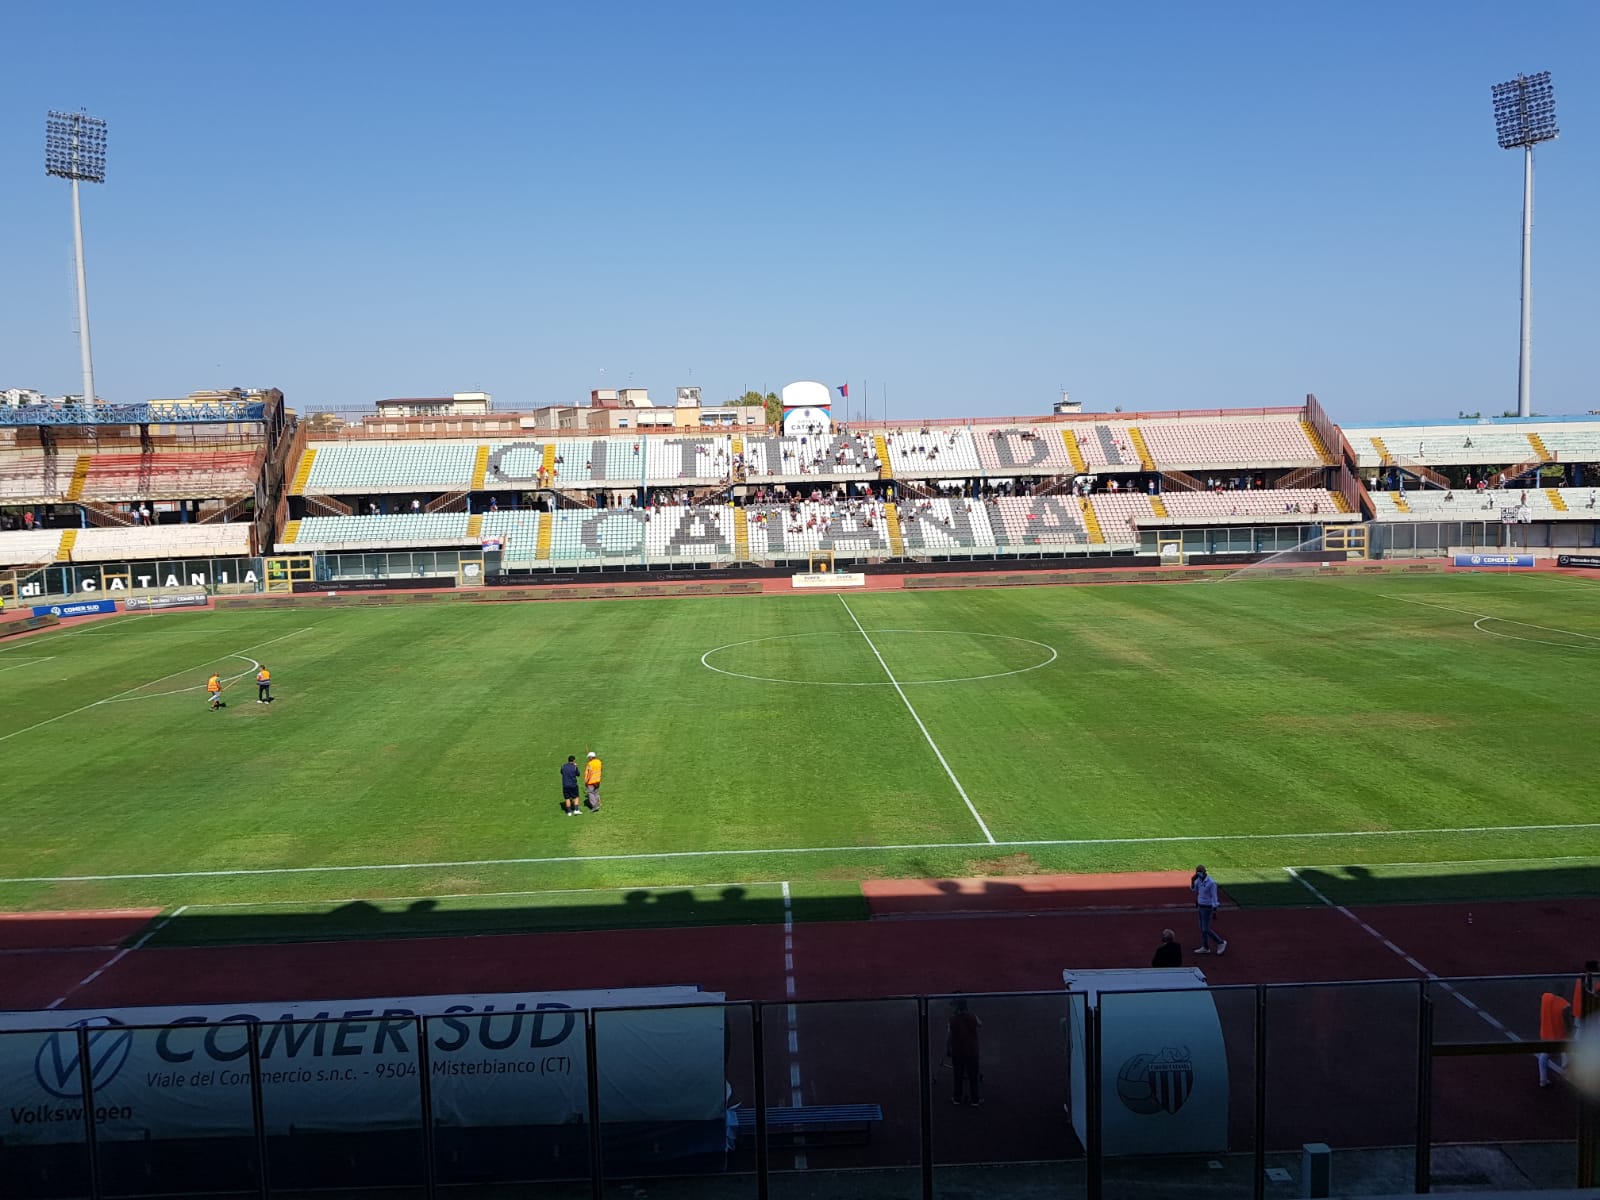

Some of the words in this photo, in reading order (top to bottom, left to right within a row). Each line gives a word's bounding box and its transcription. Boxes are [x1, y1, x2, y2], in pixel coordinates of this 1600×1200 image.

[581, 494, 1090, 557] CATANIA
[21, 582, 40, 596] di
[81, 570, 258, 592] CATANIA
[63, 605, 87, 613] COMER
[156, 1008, 416, 1064] COMER
[434, 1003, 575, 1052] SUD
[145, 1072, 185, 1089] Viale
[190, 1070, 215, 1087] del
[317, 1067, 358, 1082] s.n.c.
[376, 1063, 421, 1080] 9504
[433, 1059, 536, 1076] Misterbianco
[541, 1057, 571, 1077] (CT)
[10, 1105, 133, 1125] Volkswgen
